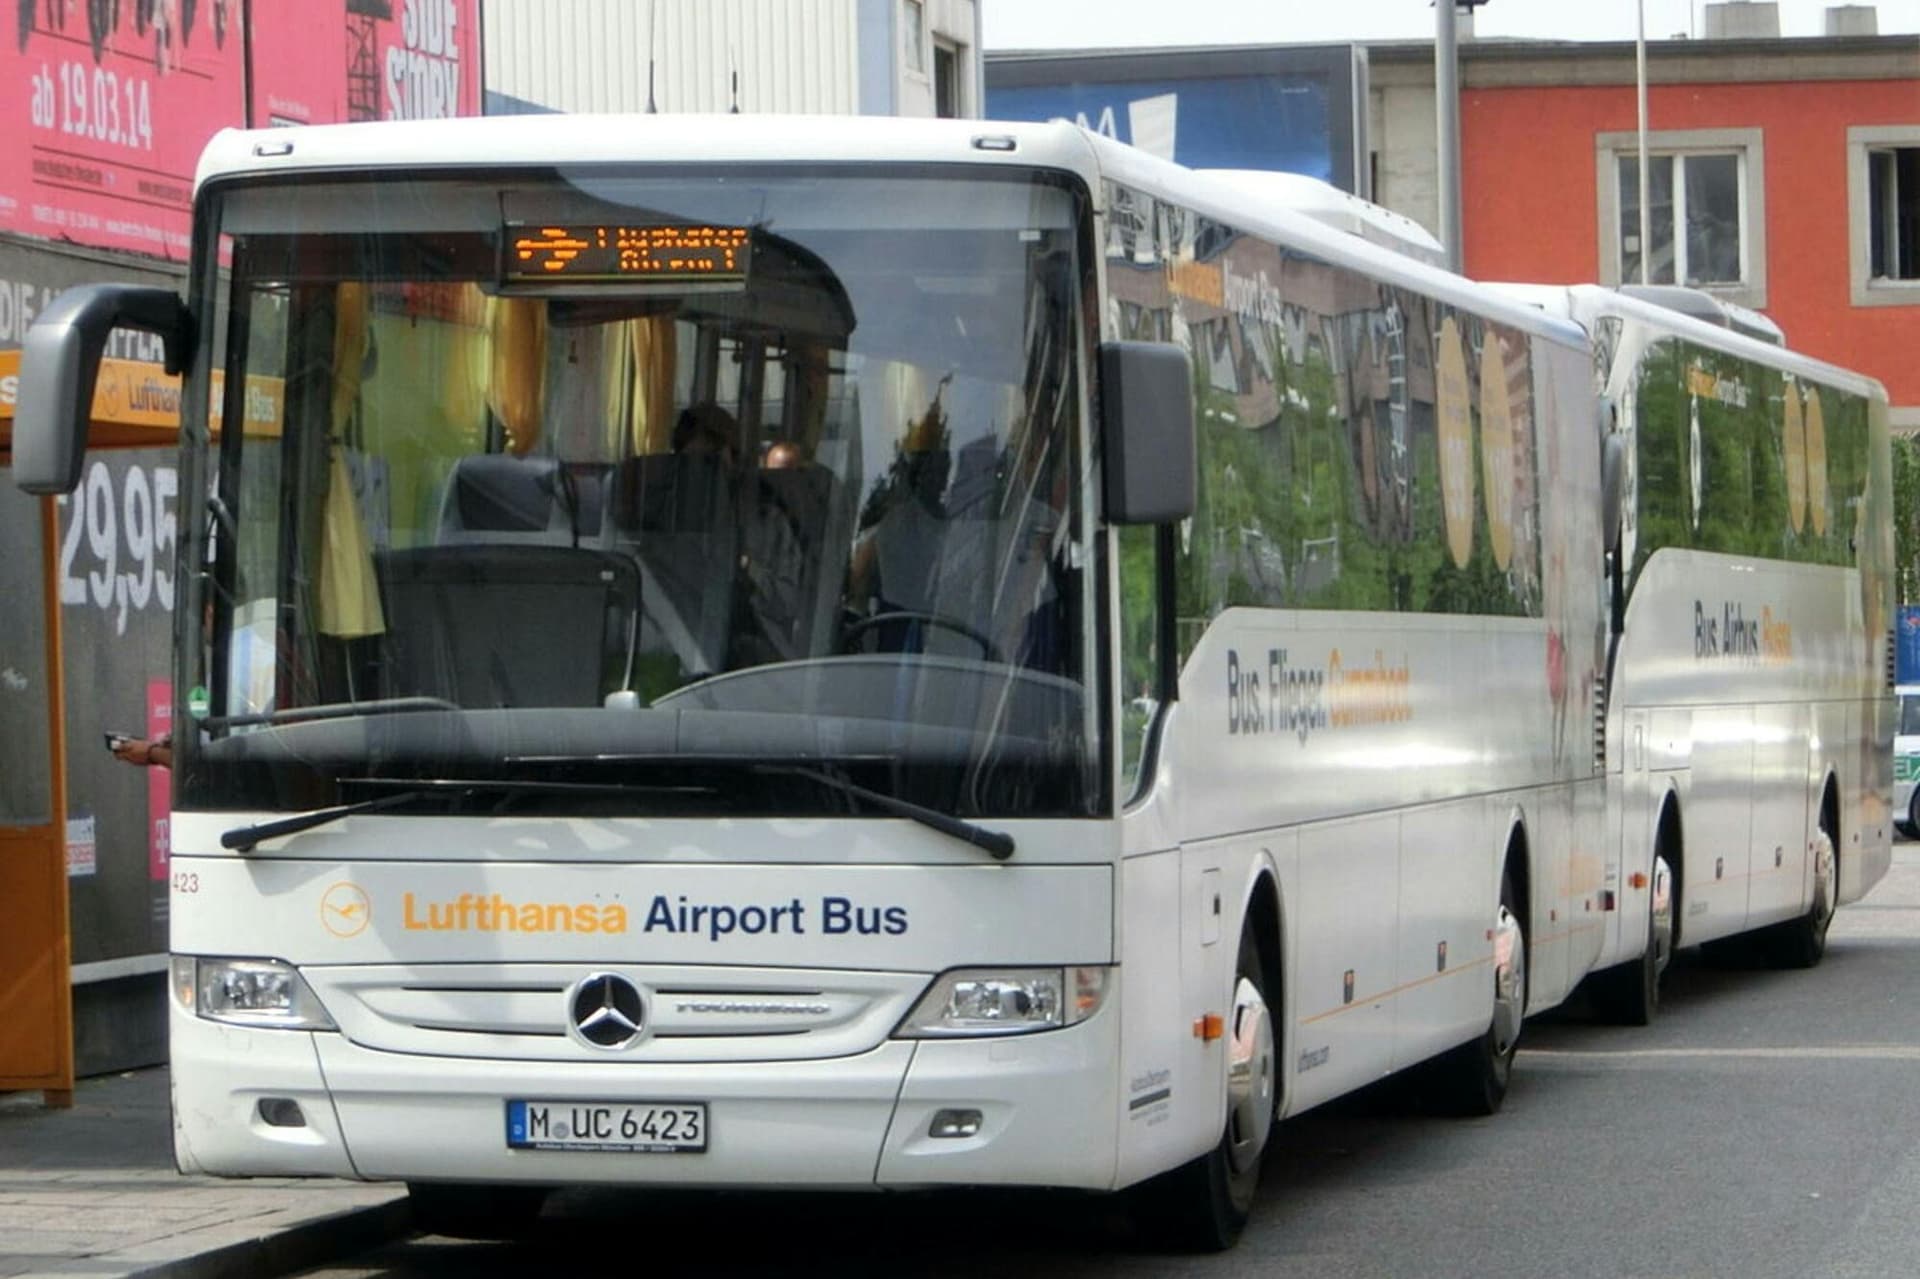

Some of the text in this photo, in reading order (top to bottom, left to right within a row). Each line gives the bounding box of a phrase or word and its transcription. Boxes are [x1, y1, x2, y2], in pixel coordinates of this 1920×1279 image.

[402, 0, 458, 62] SIDE
[31, 61, 152, 151] ab 19.03.14
[386, 46, 459, 120] STORY
[60, 461, 178, 636] 29,95
[402, 891, 909, 942] Lufthansa Airport Bus
[529, 1107, 699, 1141] M UC 6423
